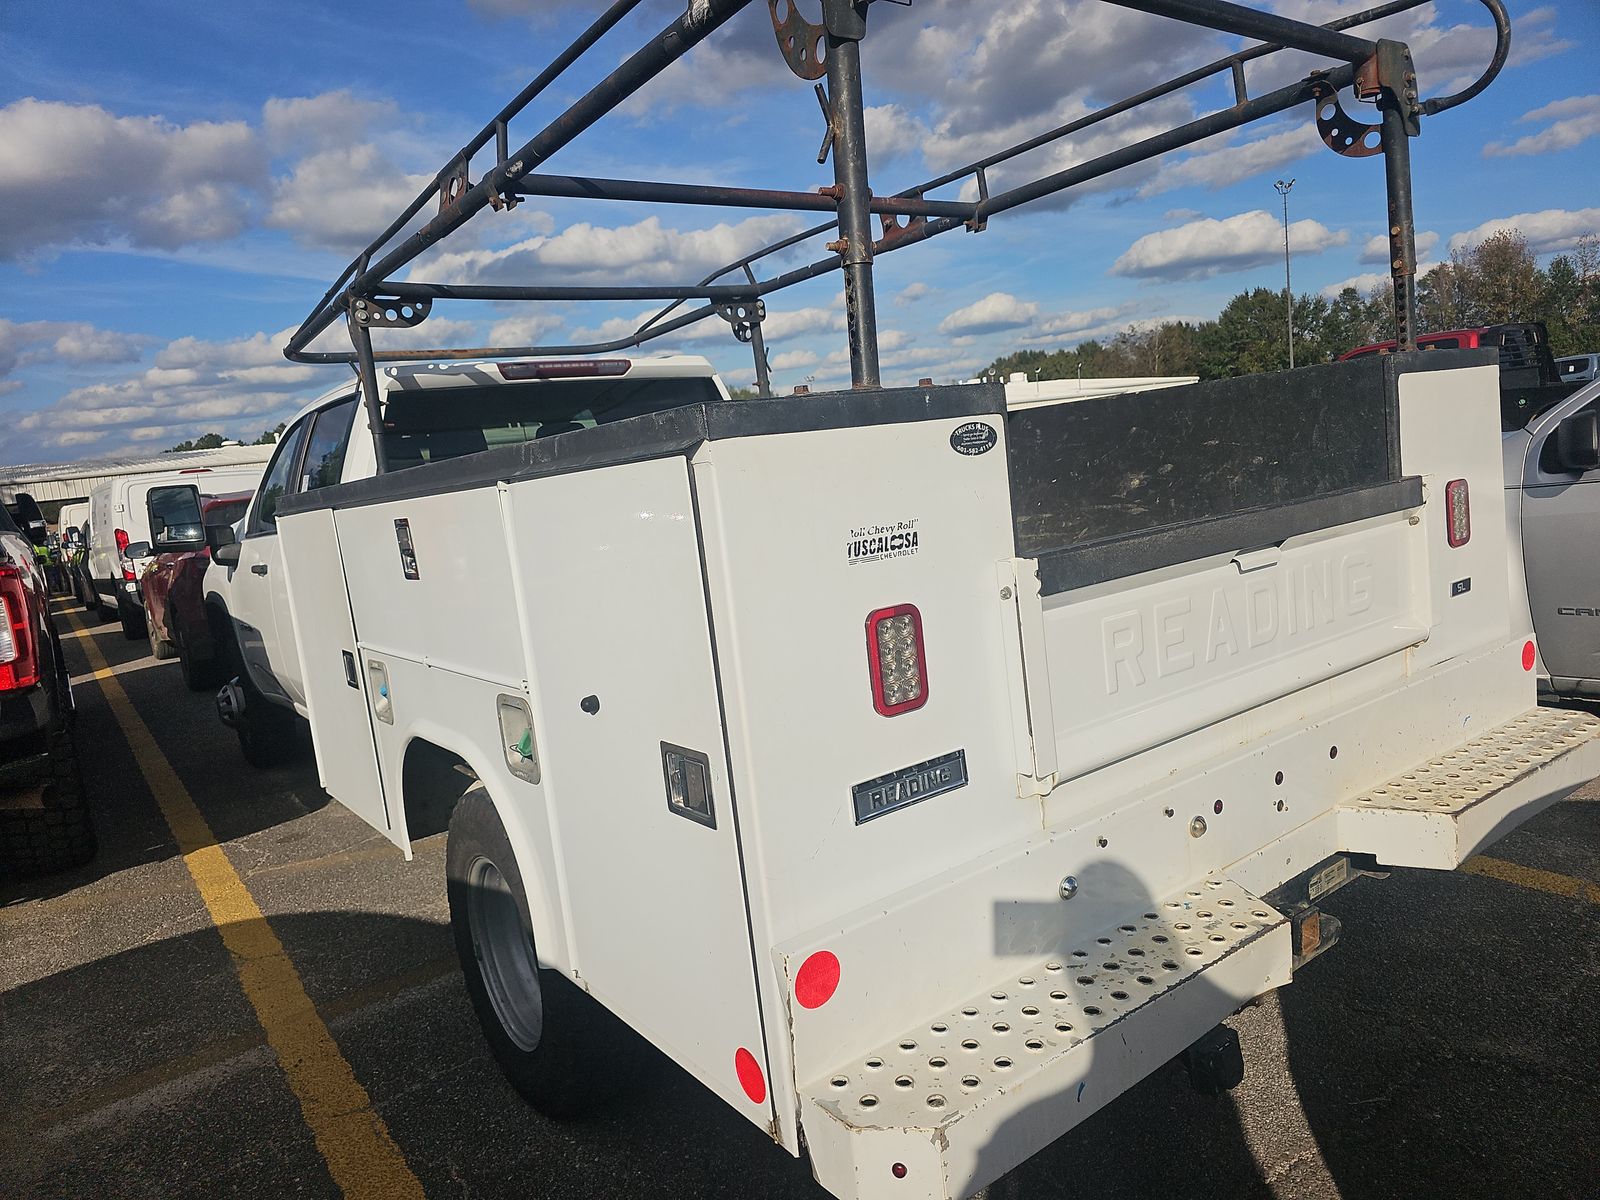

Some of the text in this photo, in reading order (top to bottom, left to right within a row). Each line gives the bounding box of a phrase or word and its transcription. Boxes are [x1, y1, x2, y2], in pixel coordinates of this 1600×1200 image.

[955, 424, 975, 436] TRUCKS
[868, 525, 895, 536] Chevy
[880, 548, 918, 560] CHEVROLET
[1456, 582, 1466, 593] SL
[1101, 550, 1375, 695] READING
[868, 766, 952, 810] READING
